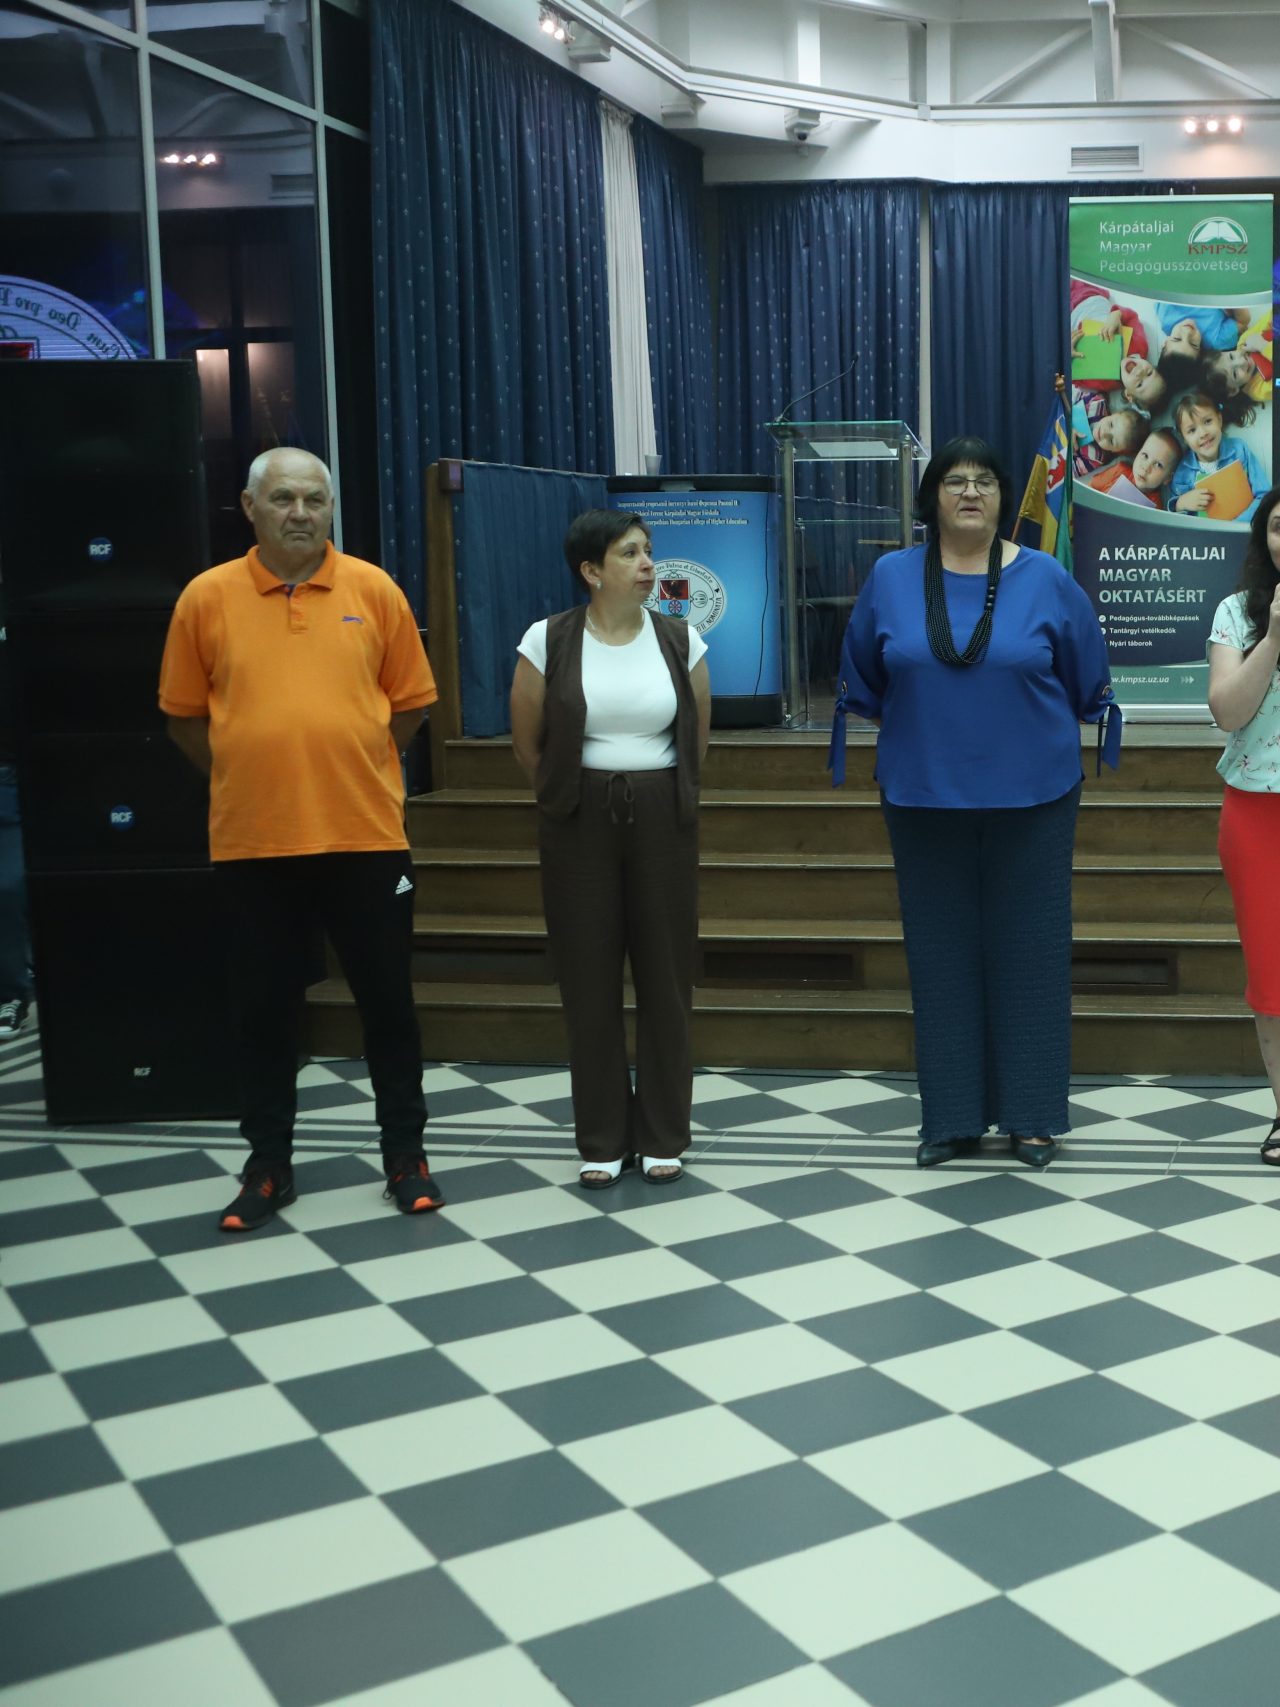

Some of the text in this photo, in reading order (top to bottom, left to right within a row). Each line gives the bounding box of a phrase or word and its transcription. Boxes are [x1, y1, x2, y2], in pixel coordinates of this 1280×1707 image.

[1099, 220, 1174, 236] Kárpátaljai
[1100, 240, 1152, 256] Magyar
[1188, 244, 1248, 255] KMPSZ
[1100, 258, 1249, 275] Pedagógusszövetség
[90, 544, 112, 555] RCF
[1099, 545, 1226, 561] A KÁRPÁTALJAI
[1099, 568, 1172, 582] MAGYAR
[1099, 587, 1206, 603] OKTATÁSÉRT
[1109, 614, 1200, 623] Pedagógus-továbbképzések
[1109, 627, 1140, 635] Tantárgyi
[1109, 640, 1127, 648] Nyári
[1110, 675, 1170, 685] w.kmpsz.uz.ua
[111, 812, 132, 823] RCF
